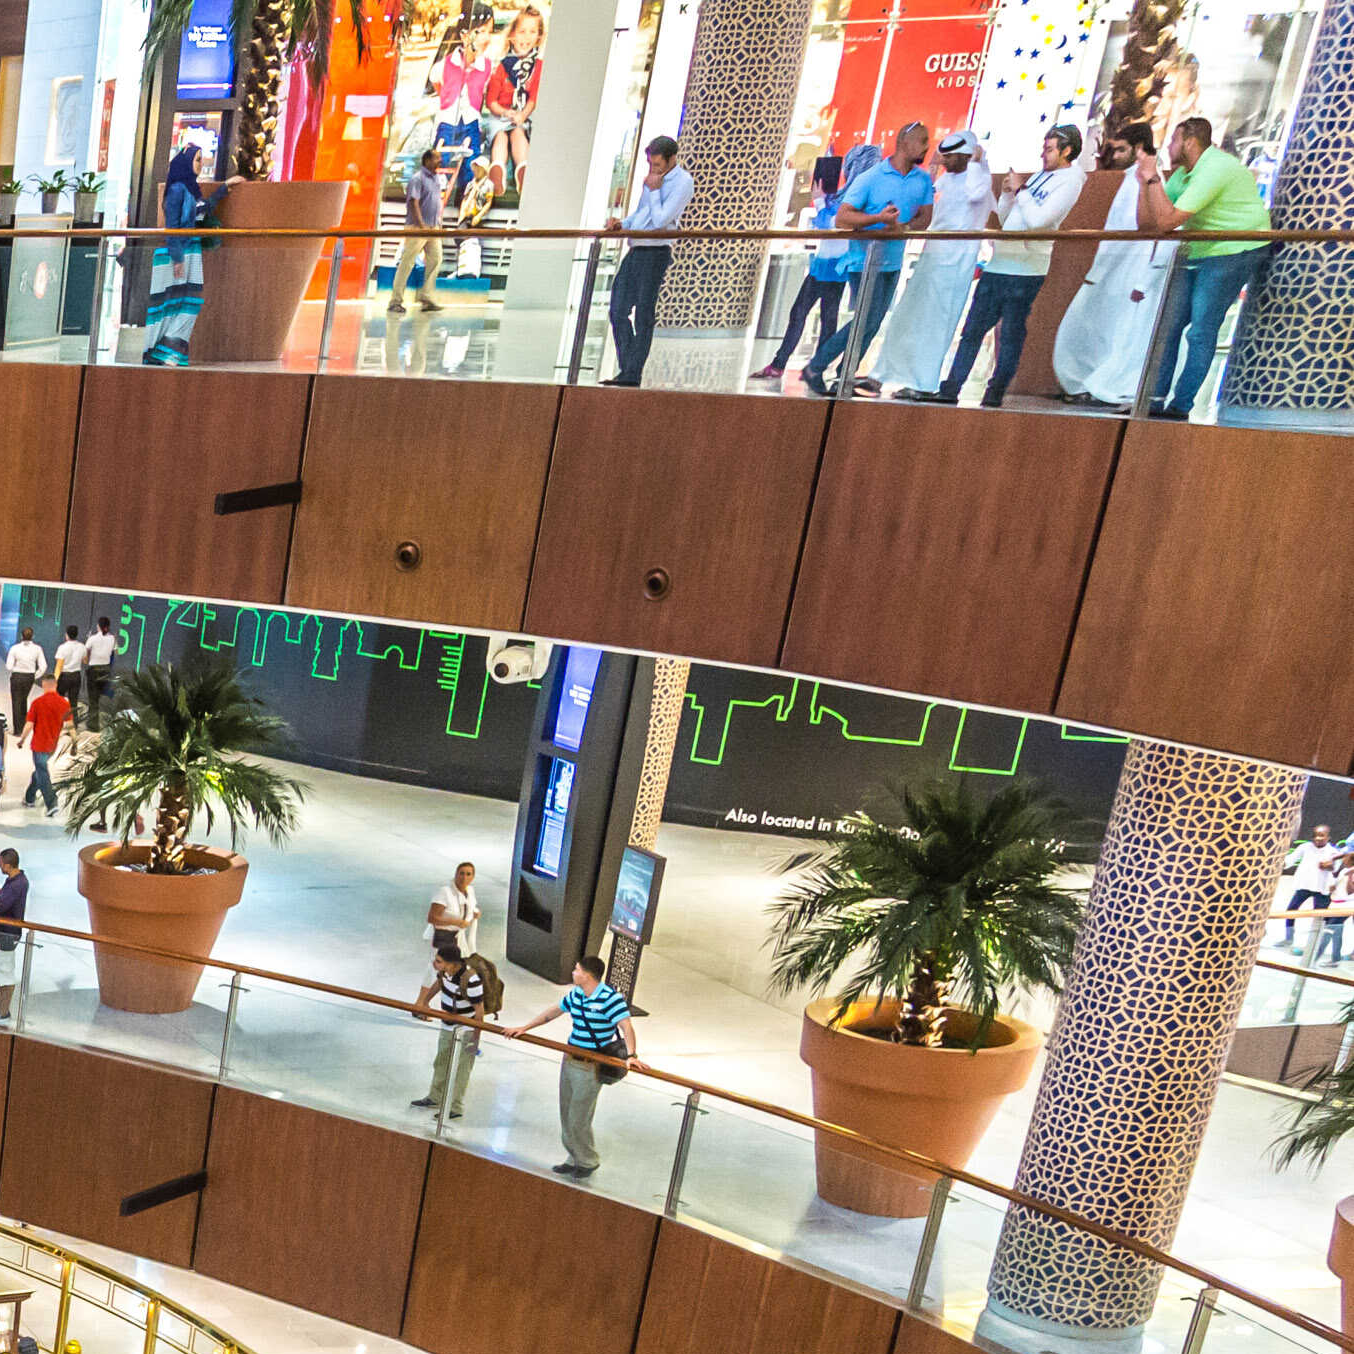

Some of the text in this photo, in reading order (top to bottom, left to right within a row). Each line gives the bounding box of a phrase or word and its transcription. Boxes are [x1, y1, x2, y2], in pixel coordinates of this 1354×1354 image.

[924, 52, 987, 73] GUES
[936, 75, 976, 88] KIDS
[725, 808, 757, 823] Also
[761, 811, 815, 830] located
[818, 818, 831, 832] in
